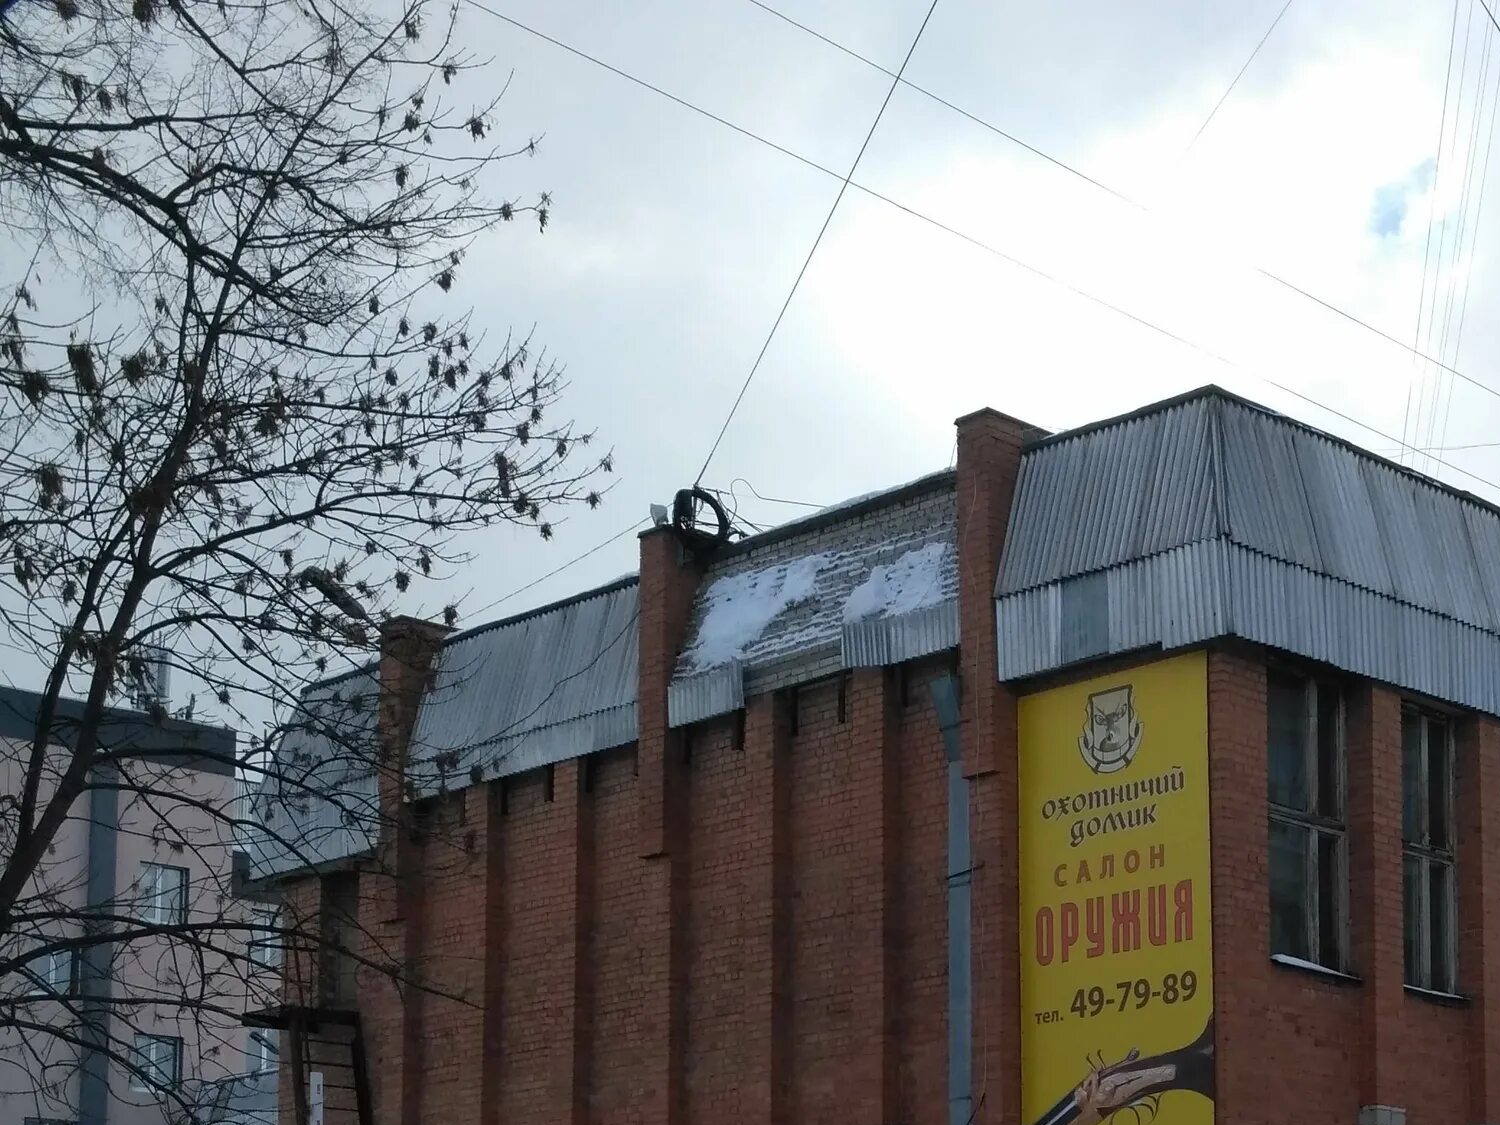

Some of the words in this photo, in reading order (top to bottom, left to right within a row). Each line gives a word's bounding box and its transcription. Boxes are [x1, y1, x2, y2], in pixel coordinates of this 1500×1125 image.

[1041, 765, 1185, 821] охотничий
[1069, 803, 1157, 848] домик
[1054, 844, 1165, 887] САЛОН
[1035, 879, 1193, 967] ОРУЖИЯ
[1034, 1009, 1064, 1025] тел.
[1070, 970, 1197, 1019] 49-79-89
